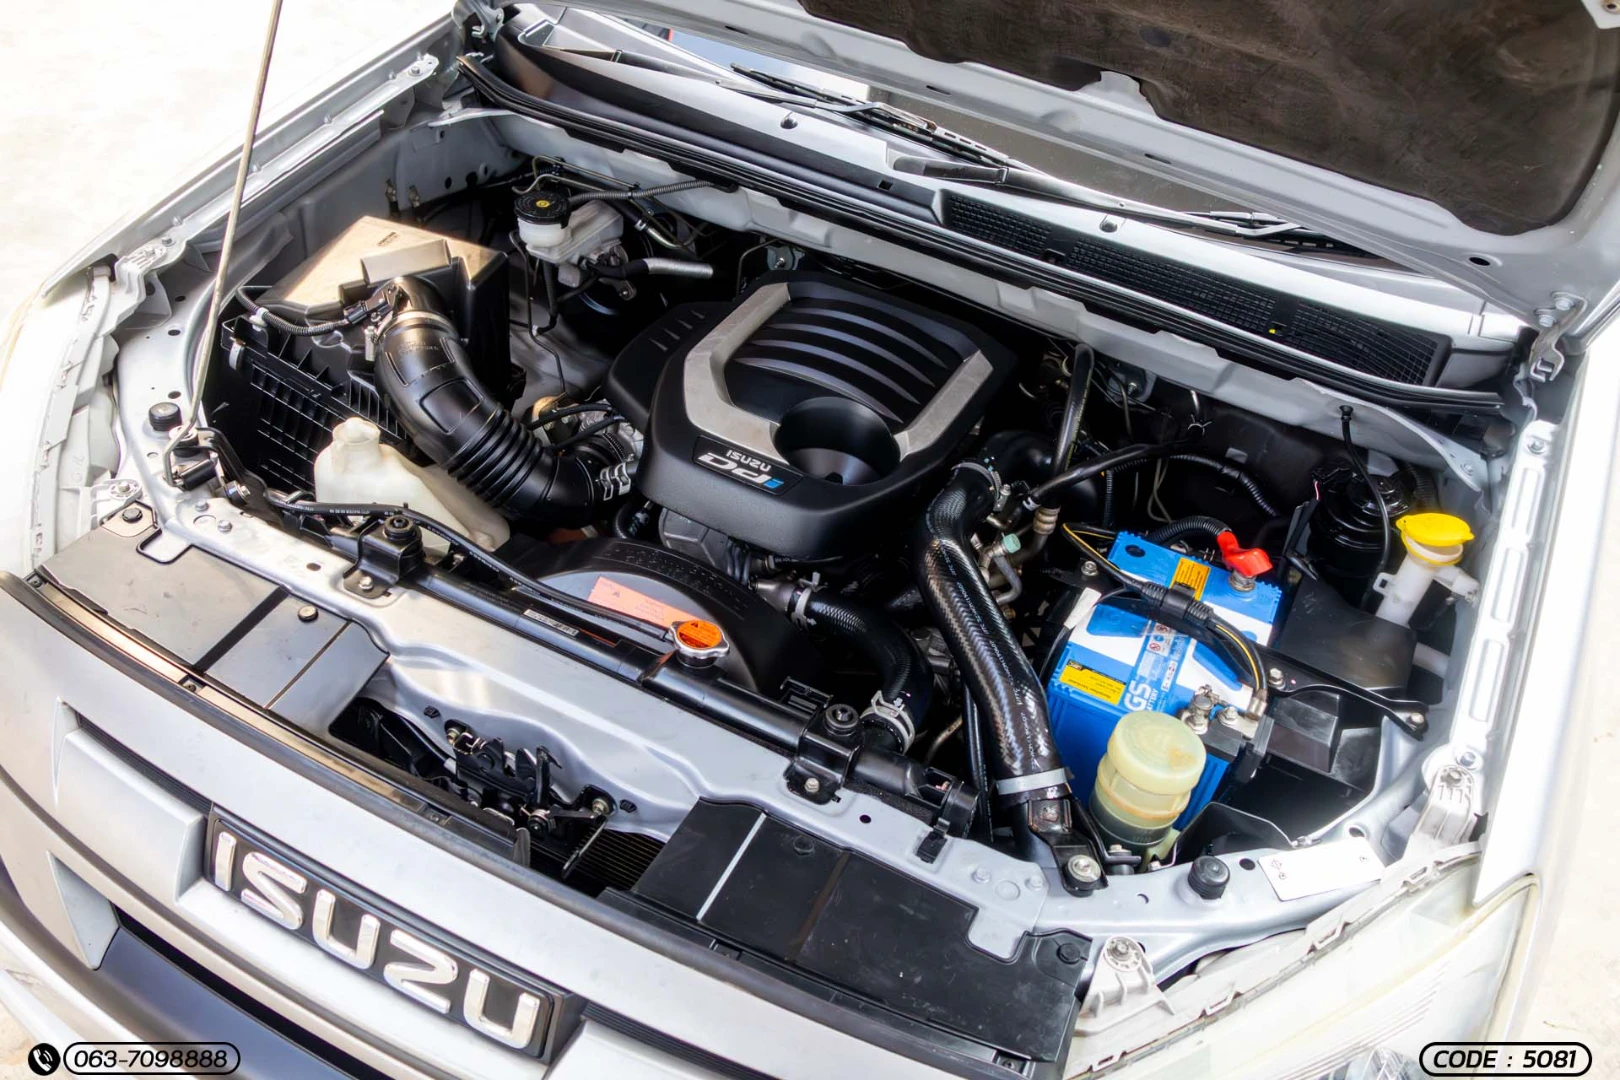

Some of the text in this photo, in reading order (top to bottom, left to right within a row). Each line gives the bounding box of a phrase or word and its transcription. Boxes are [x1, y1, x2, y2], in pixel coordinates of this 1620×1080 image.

[726, 450, 772, 472] ISUZU
[1124, 680, 1151, 711] GS
[214, 831, 541, 1050] ISUZU
